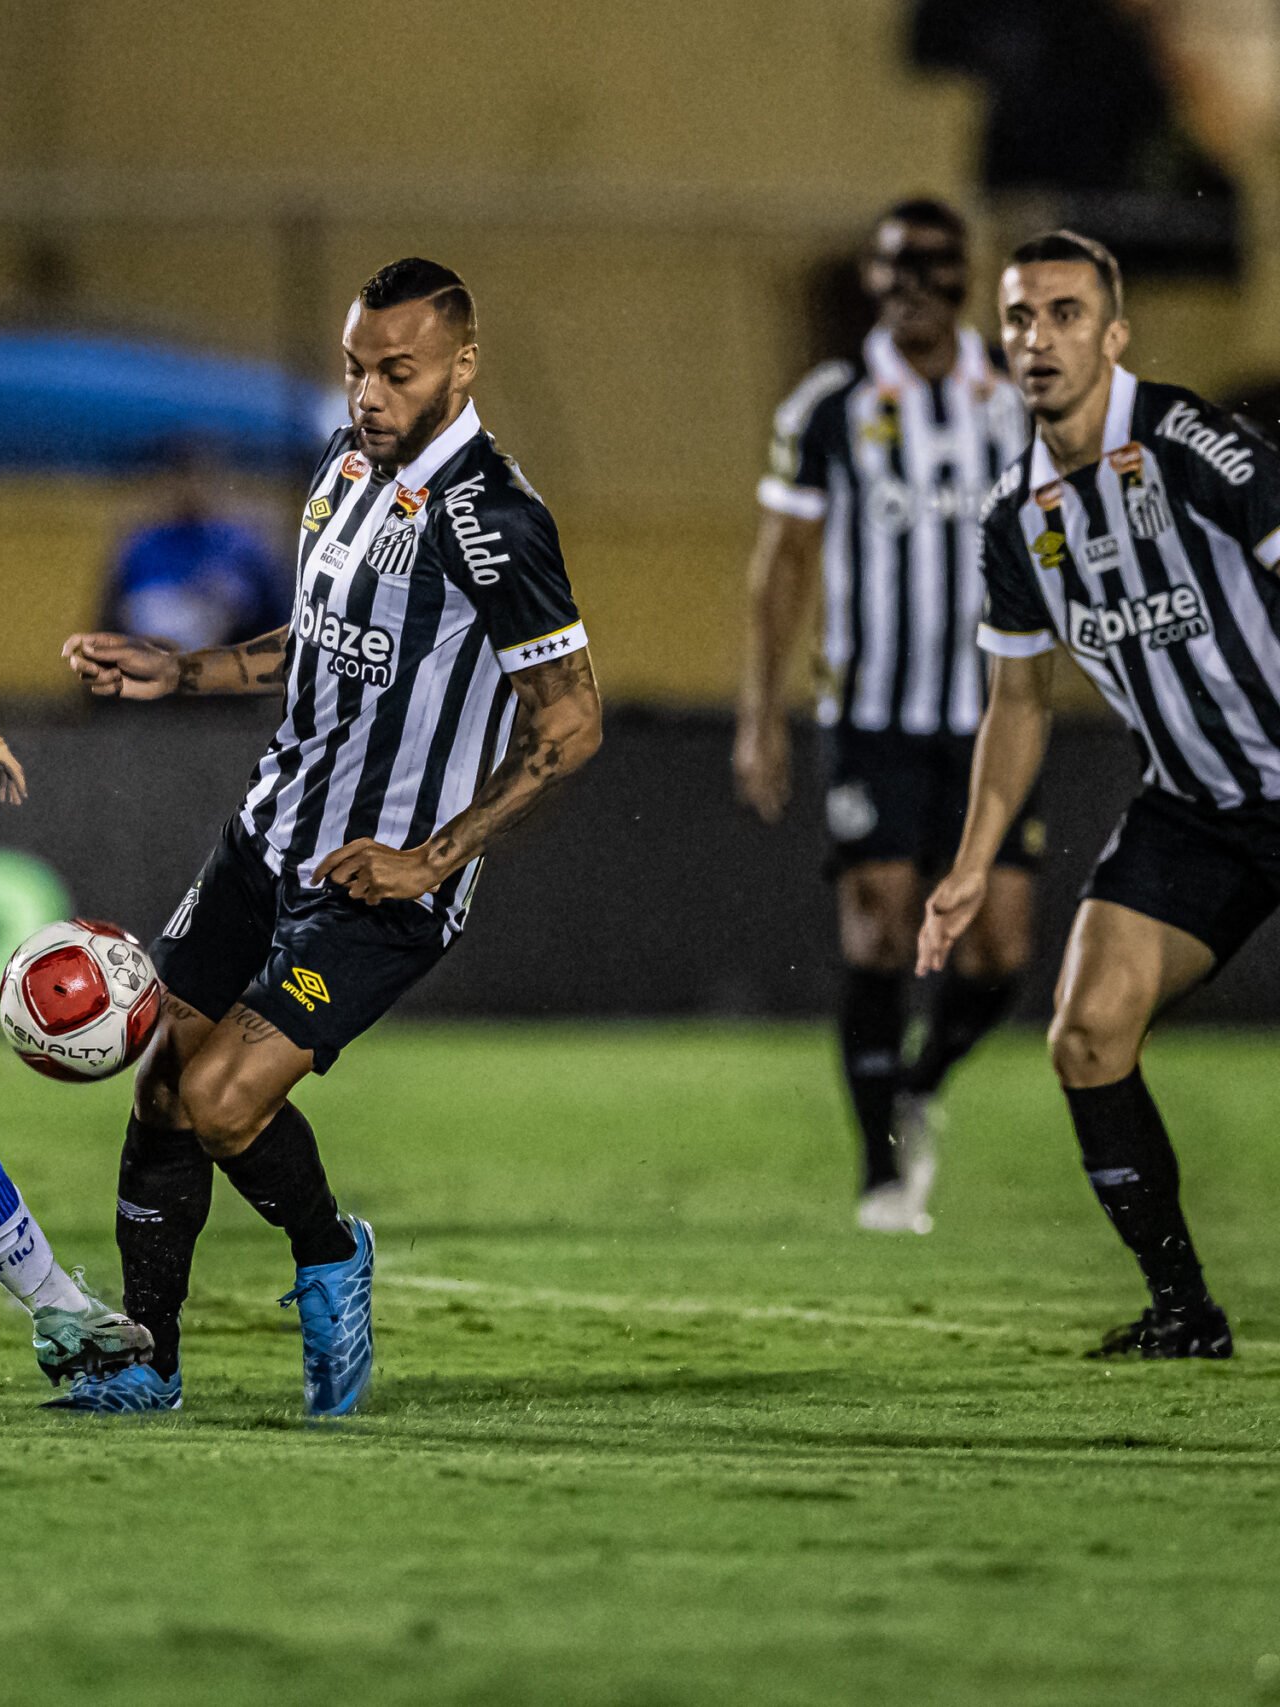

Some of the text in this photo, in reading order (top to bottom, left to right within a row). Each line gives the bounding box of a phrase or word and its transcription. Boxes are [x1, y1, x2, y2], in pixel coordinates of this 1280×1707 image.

[443, 470, 511, 585] Kicaldo
[300, 595, 391, 663] blaze
[330, 656, 388, 685] .com
[281, 979, 315, 1013] umbro
[4, 1013, 114, 1059] PENALTY
